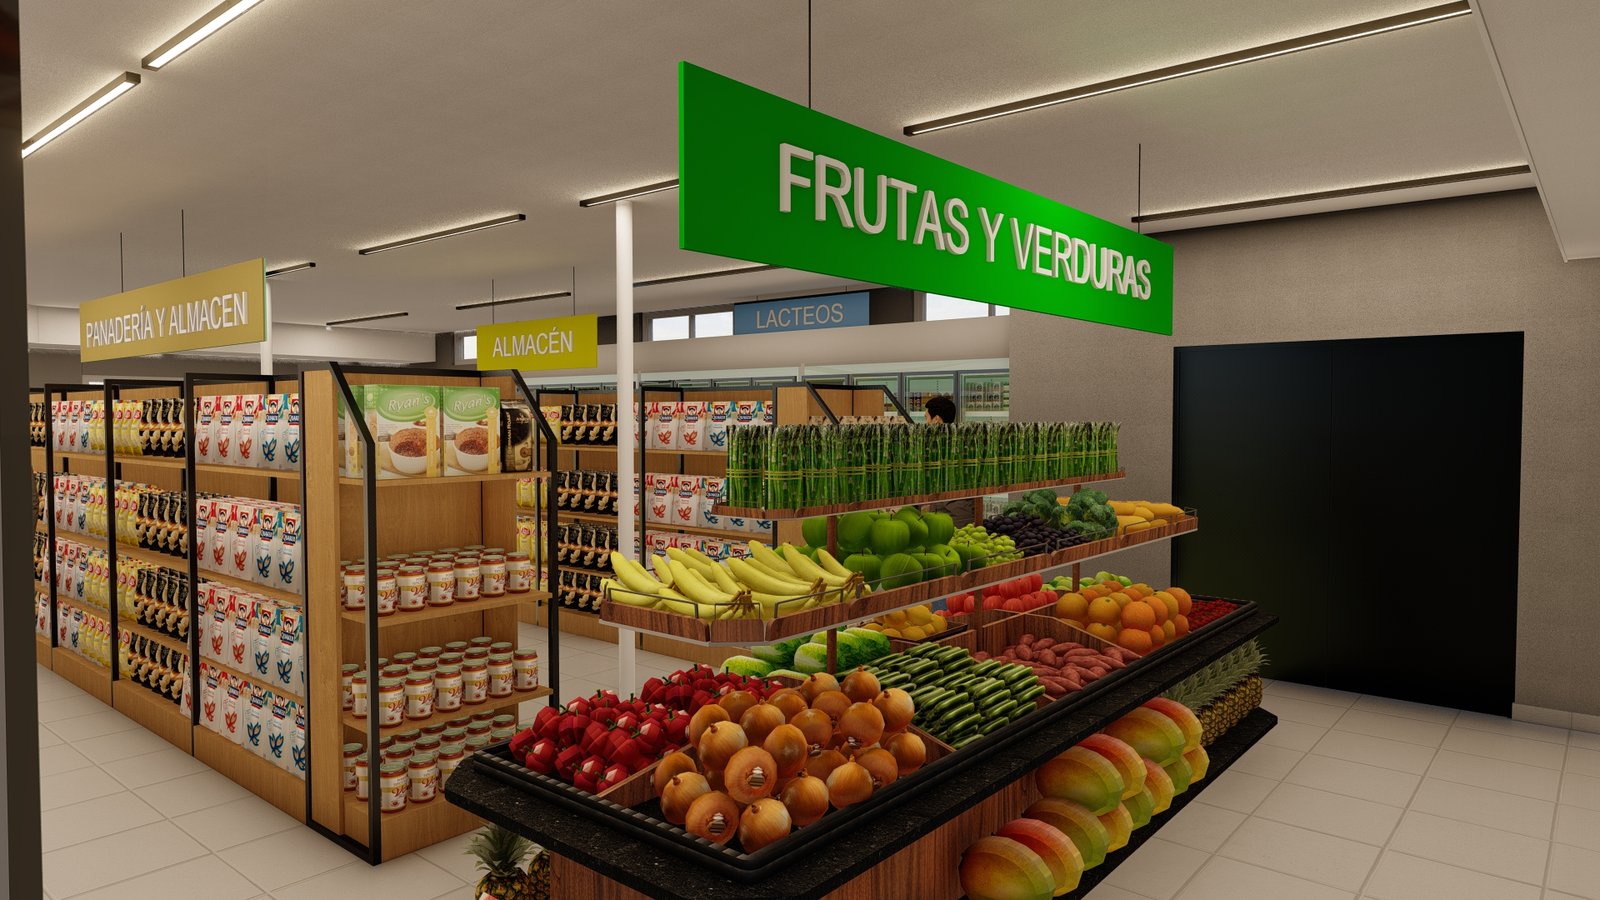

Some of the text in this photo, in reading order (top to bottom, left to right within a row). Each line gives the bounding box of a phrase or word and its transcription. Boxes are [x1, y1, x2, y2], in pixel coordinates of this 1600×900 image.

[779, 142, 1151, 300] FRUTAS Y VERDURAS
[86, 291, 249, 348] PANADERÍA Y ALMACEN
[756, 302, 844, 329] LACTEOS
[492, 327, 573, 358] ALMACÉN
[388, 393, 430, 412] Ryan's
[453, 394, 492, 412] Ryan's
